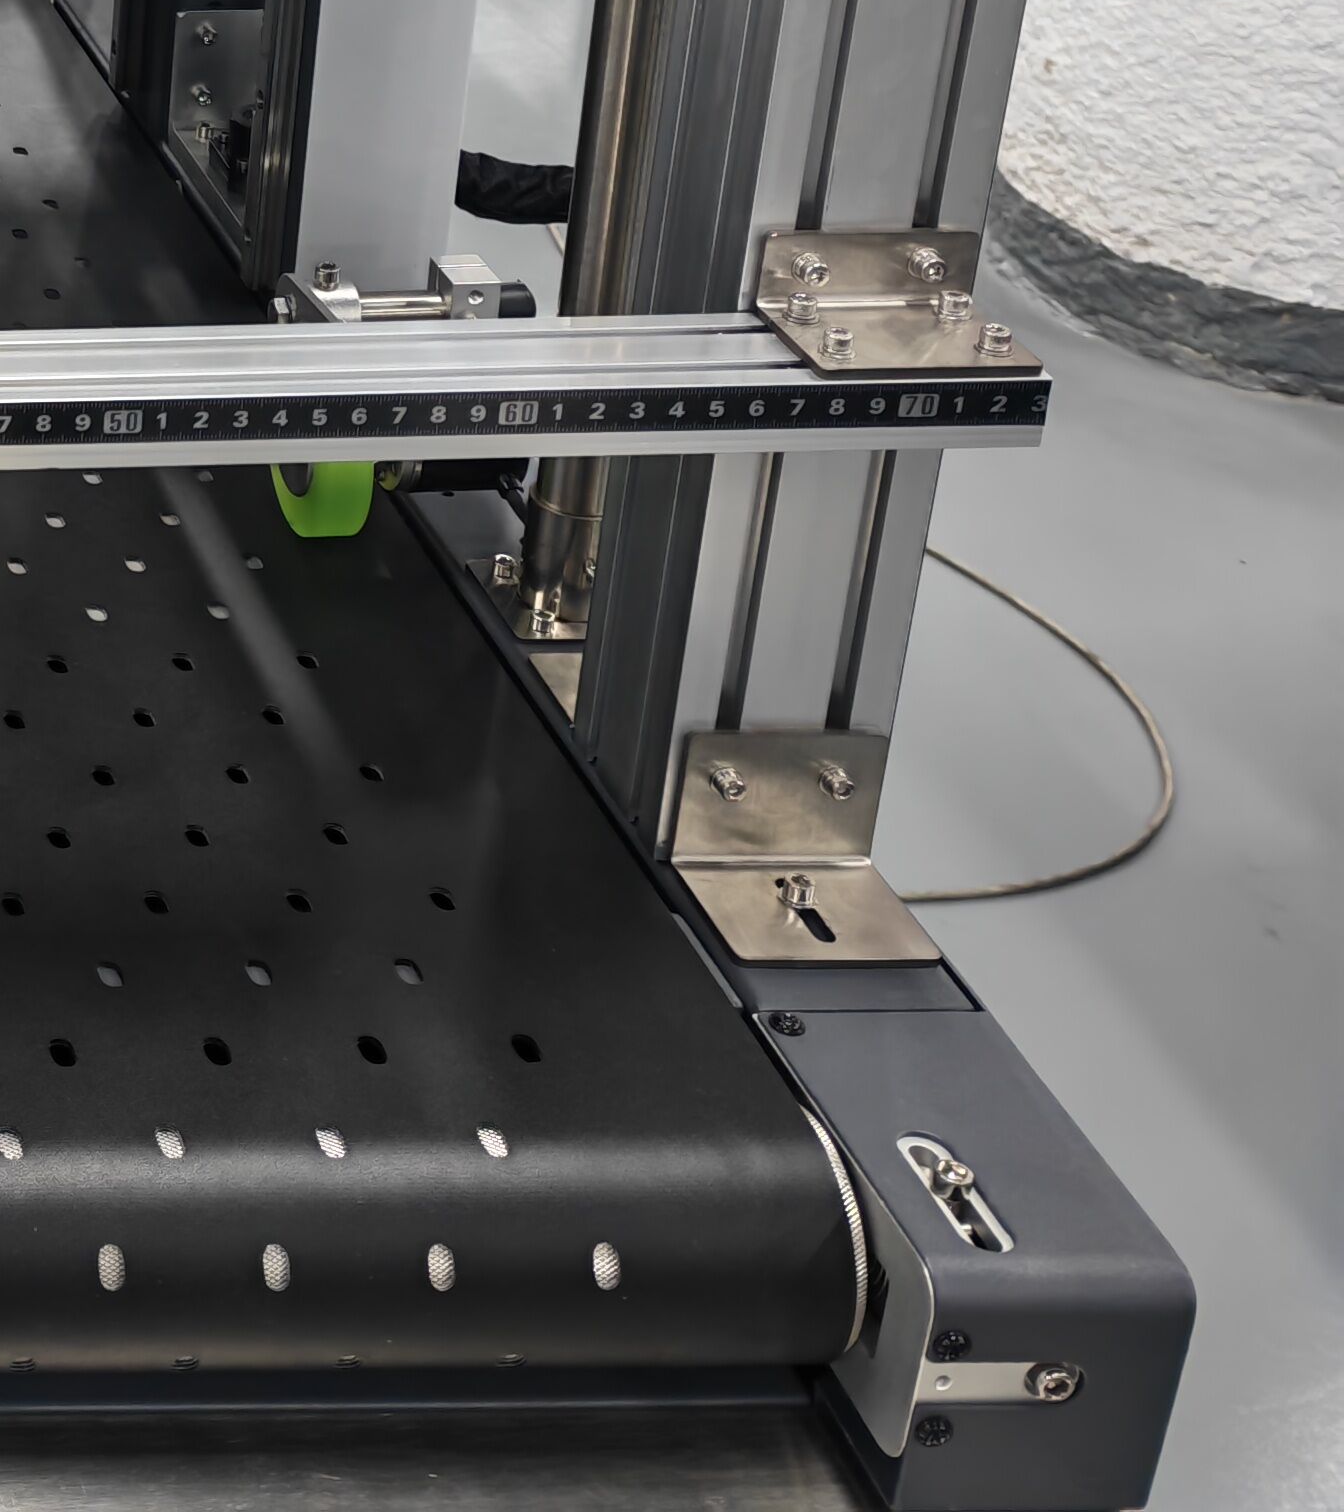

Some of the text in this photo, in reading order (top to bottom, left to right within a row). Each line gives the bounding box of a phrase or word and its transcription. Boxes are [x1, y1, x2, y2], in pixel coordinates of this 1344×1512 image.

[35, 414, 52, 432] 8
[75, 413, 91, 432] 9
[109, 412, 138, 432] 50
[156, 412, 167, 430] 1
[192, 411, 210, 429] 2
[232, 410, 249, 428] 3
[271, 409, 289, 427] 4
[311, 408, 328, 426] 5
[351, 407, 368, 425] 6
[391, 406, 408, 425] 7
[429, 405, 447, 424] 8
[470, 404, 487, 423] 9
[504, 403, 534, 423] 60
[552, 403, 563, 421] 1
[588, 402, 606, 420] 2
[628, 401, 646, 419] 3
[668, 401, 686, 418] 4
[708, 400, 725, 418] 5
[748, 399, 765, 417] 6
[790, 398, 806, 416] 7
[828, 398, 846, 416] 8
[869, 397, 886, 415] 9
[903, 395, 935, 415] 70
[953, 396, 965, 414] 1
[989, 395, 1008, 413] 2
[1030, 394, 1049, 413] 3
